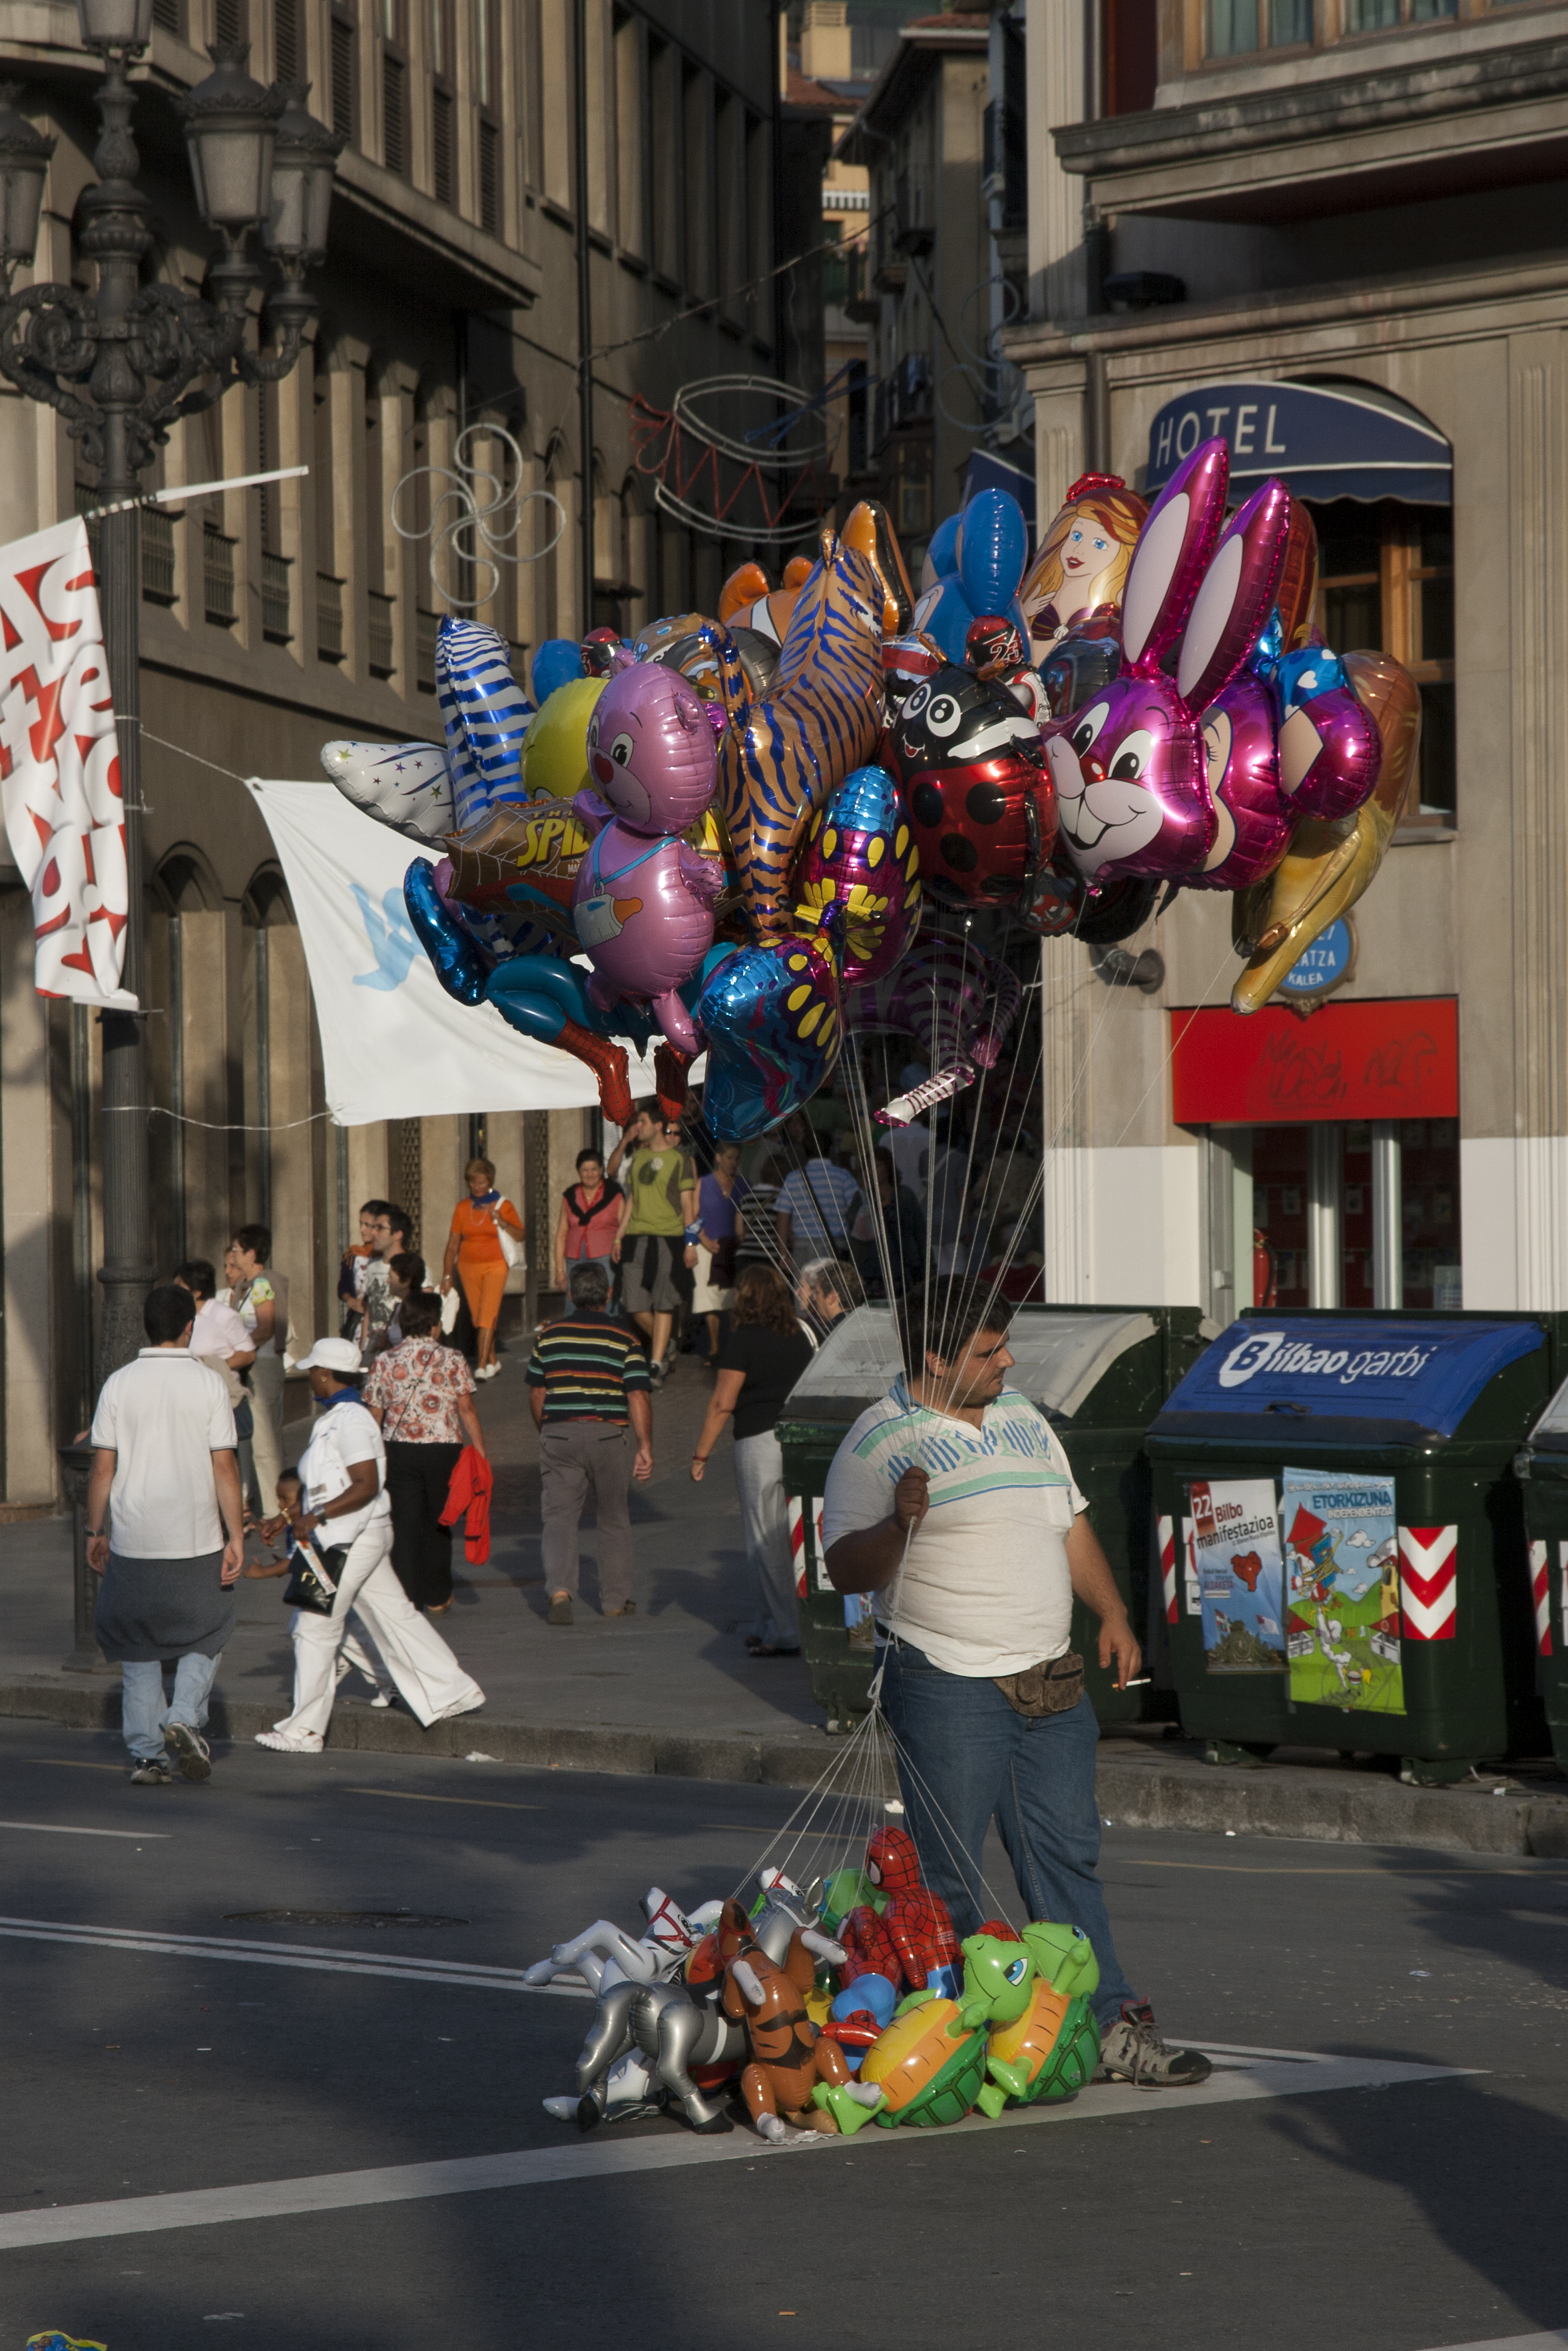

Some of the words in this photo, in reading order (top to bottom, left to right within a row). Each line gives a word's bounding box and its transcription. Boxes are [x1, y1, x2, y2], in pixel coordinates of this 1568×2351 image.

[1156, 404, 1286, 469] HOTEL
[1295, 950, 1336, 967] ATZA
[1288, 972, 1324, 985] KALEA
[1340, 1345, 1437, 1384] garbi
[1194, 1495, 1212, 1519] 22
[1312, 1491, 1392, 1509] ETORKIZUNA
[1215, 1503, 1243, 1523] Bilbo
[1327, 1506, 1394, 1519] INDEPENDENTZIA
[1196, 1516, 1274, 1550] manifestazioa
